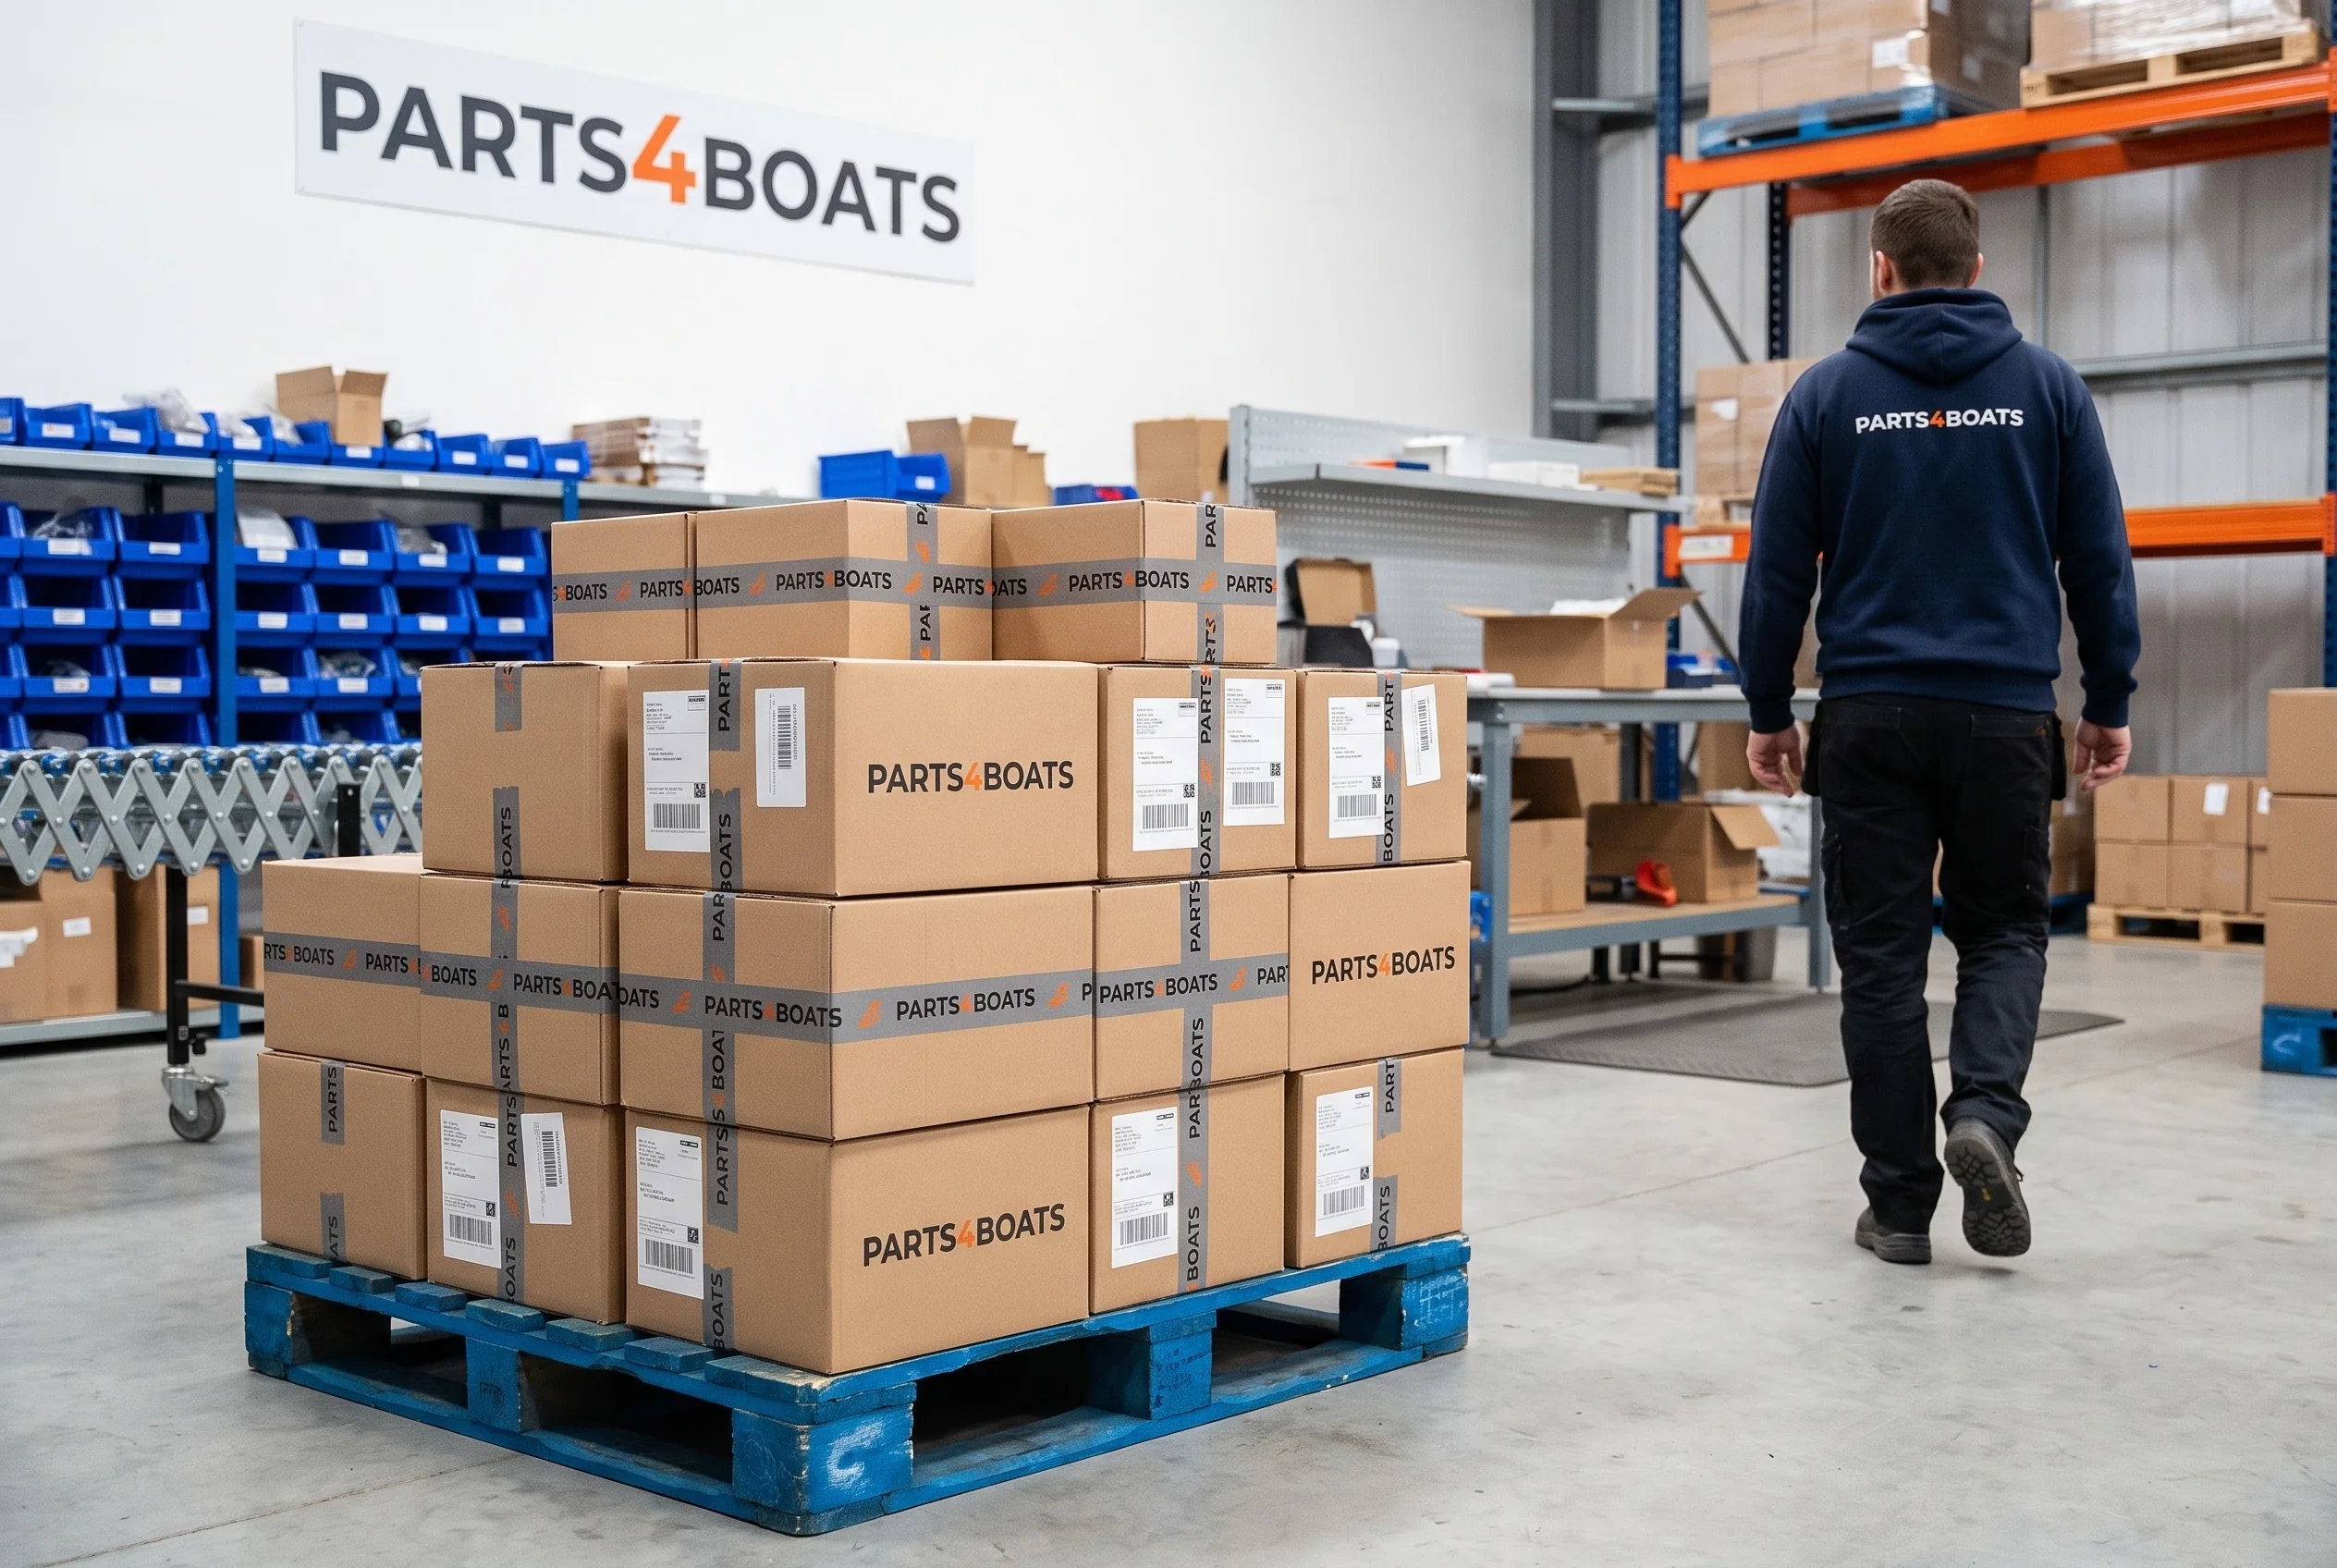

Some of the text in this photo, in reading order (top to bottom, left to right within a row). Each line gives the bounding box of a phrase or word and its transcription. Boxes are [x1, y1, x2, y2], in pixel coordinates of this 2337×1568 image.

[320, 69, 960, 243] PARTS4BOATS
[1855, 409, 2024, 434] PARTS4BOATS
[776, 570, 892, 591] PARTS4BOATS
[1069, 570, 1190, 593] PARTS4BOATS
[868, 760, 1074, 793] PARTS4BOATS
[1383, 794, 1394, 862] BOATS
[1190, 881, 1201, 952] PARTS
[1312, 946, 1455, 985] PARTS4BOATS
[897, 988, 1035, 1021] PARTS4BOATS
[1099, 974, 1218, 1003] PARTS4BOATS
[704, 995, 842, 1028] PARTS4BOATS
[328, 1066, 337, 1133] PARTS
[507, 1096, 517, 1167] PARTS
[716, 1127, 728, 1206] PARTS
[863, 1203, 1066, 1267] PARTS4BOATS
